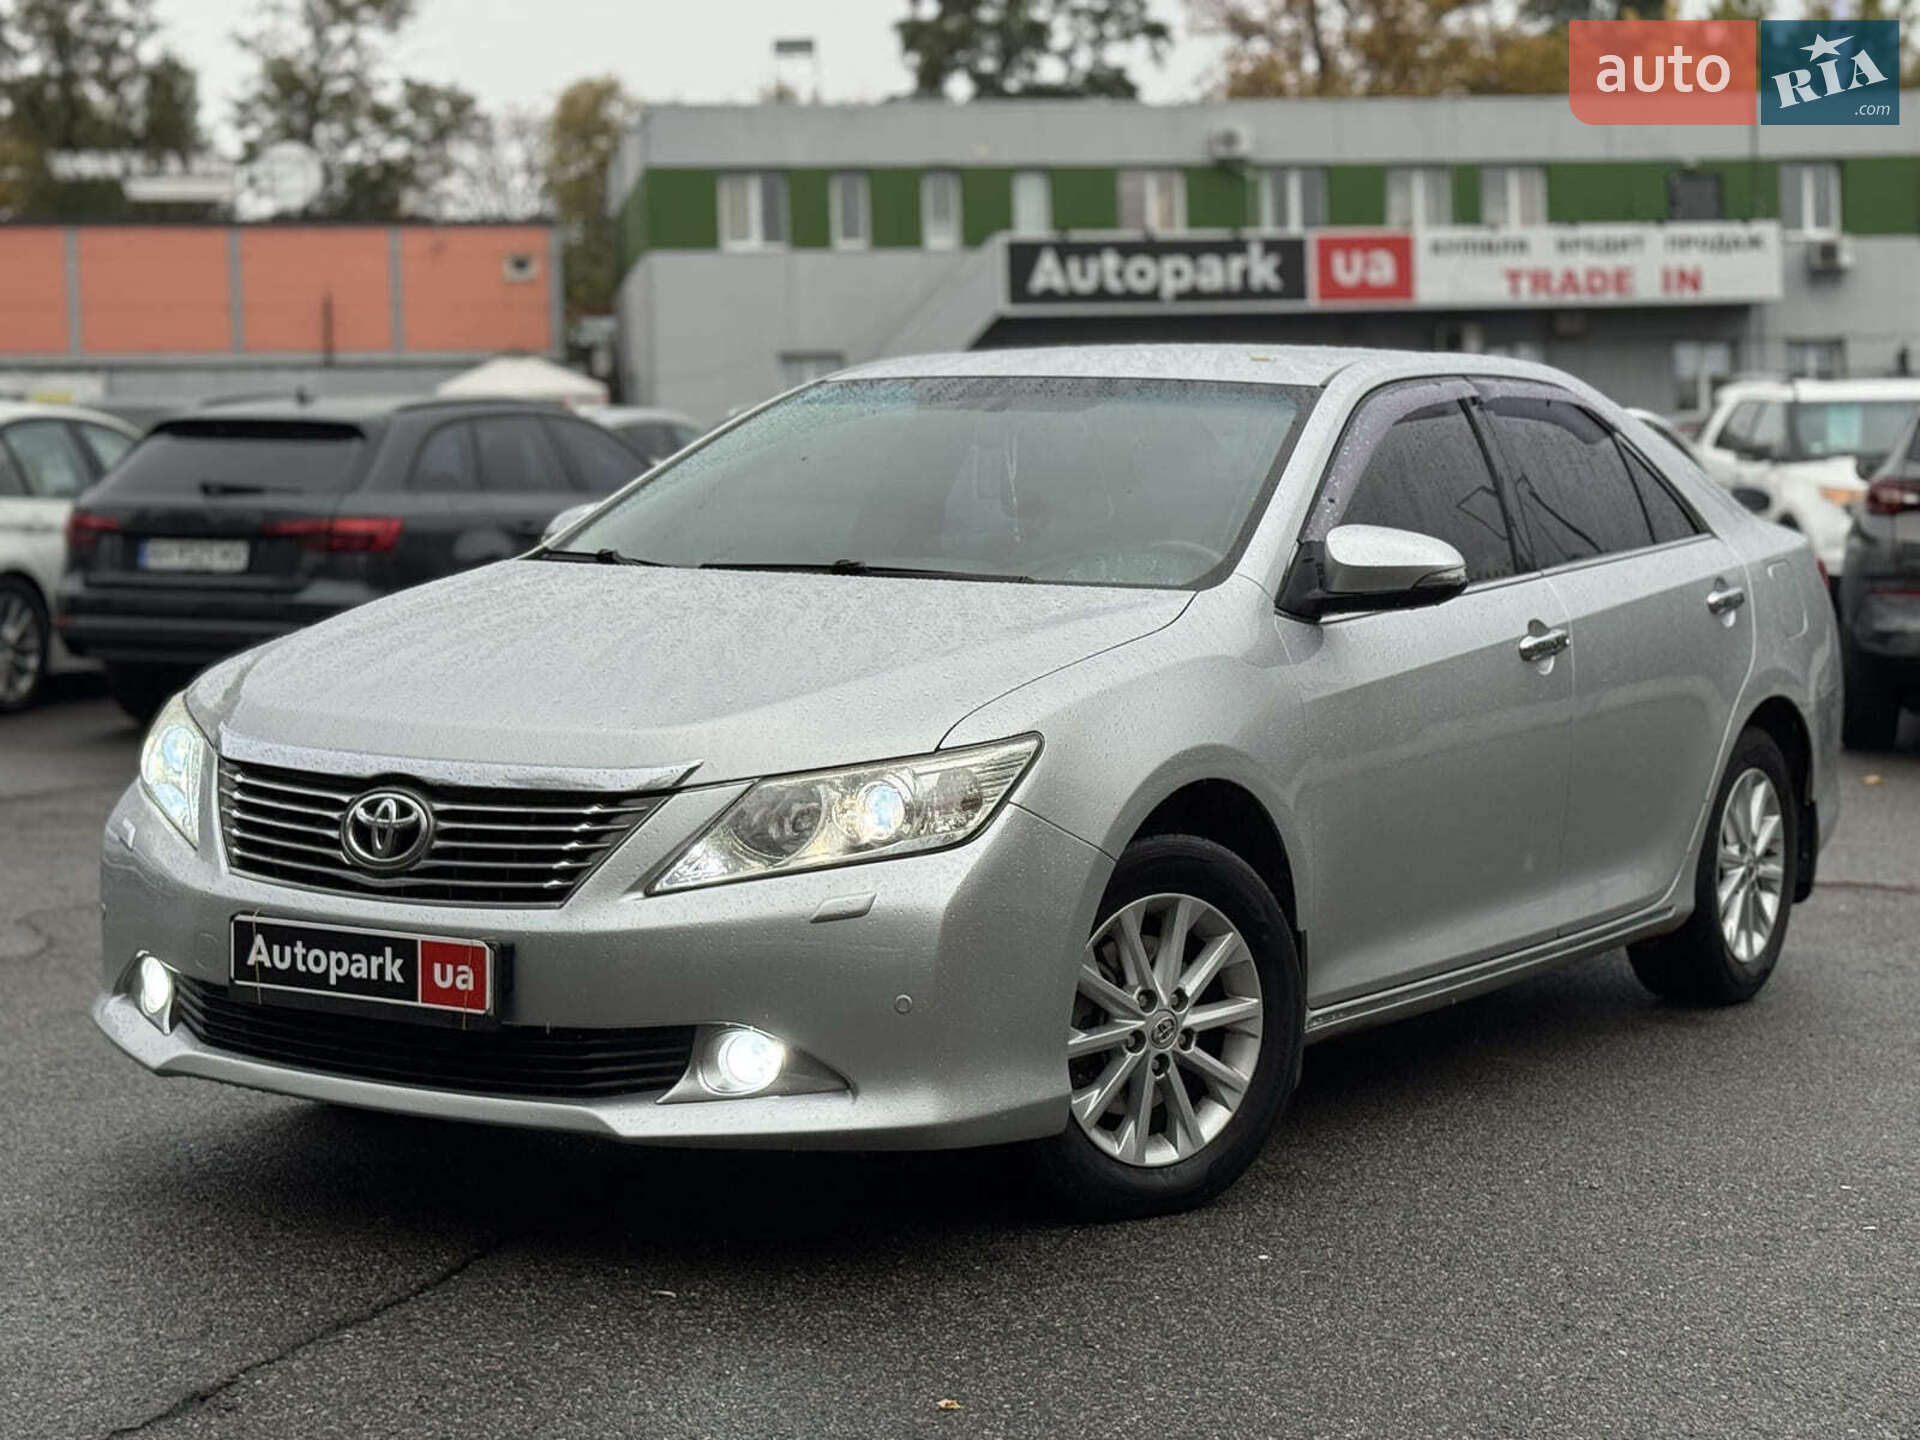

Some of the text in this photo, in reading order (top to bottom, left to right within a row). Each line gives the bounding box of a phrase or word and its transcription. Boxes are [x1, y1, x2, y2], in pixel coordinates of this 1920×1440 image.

[1027, 241, 1396, 300] Autopark ua
[1504, 266, 1703, 296] TRADE IN
[247, 933, 475, 991] Autopark ua
